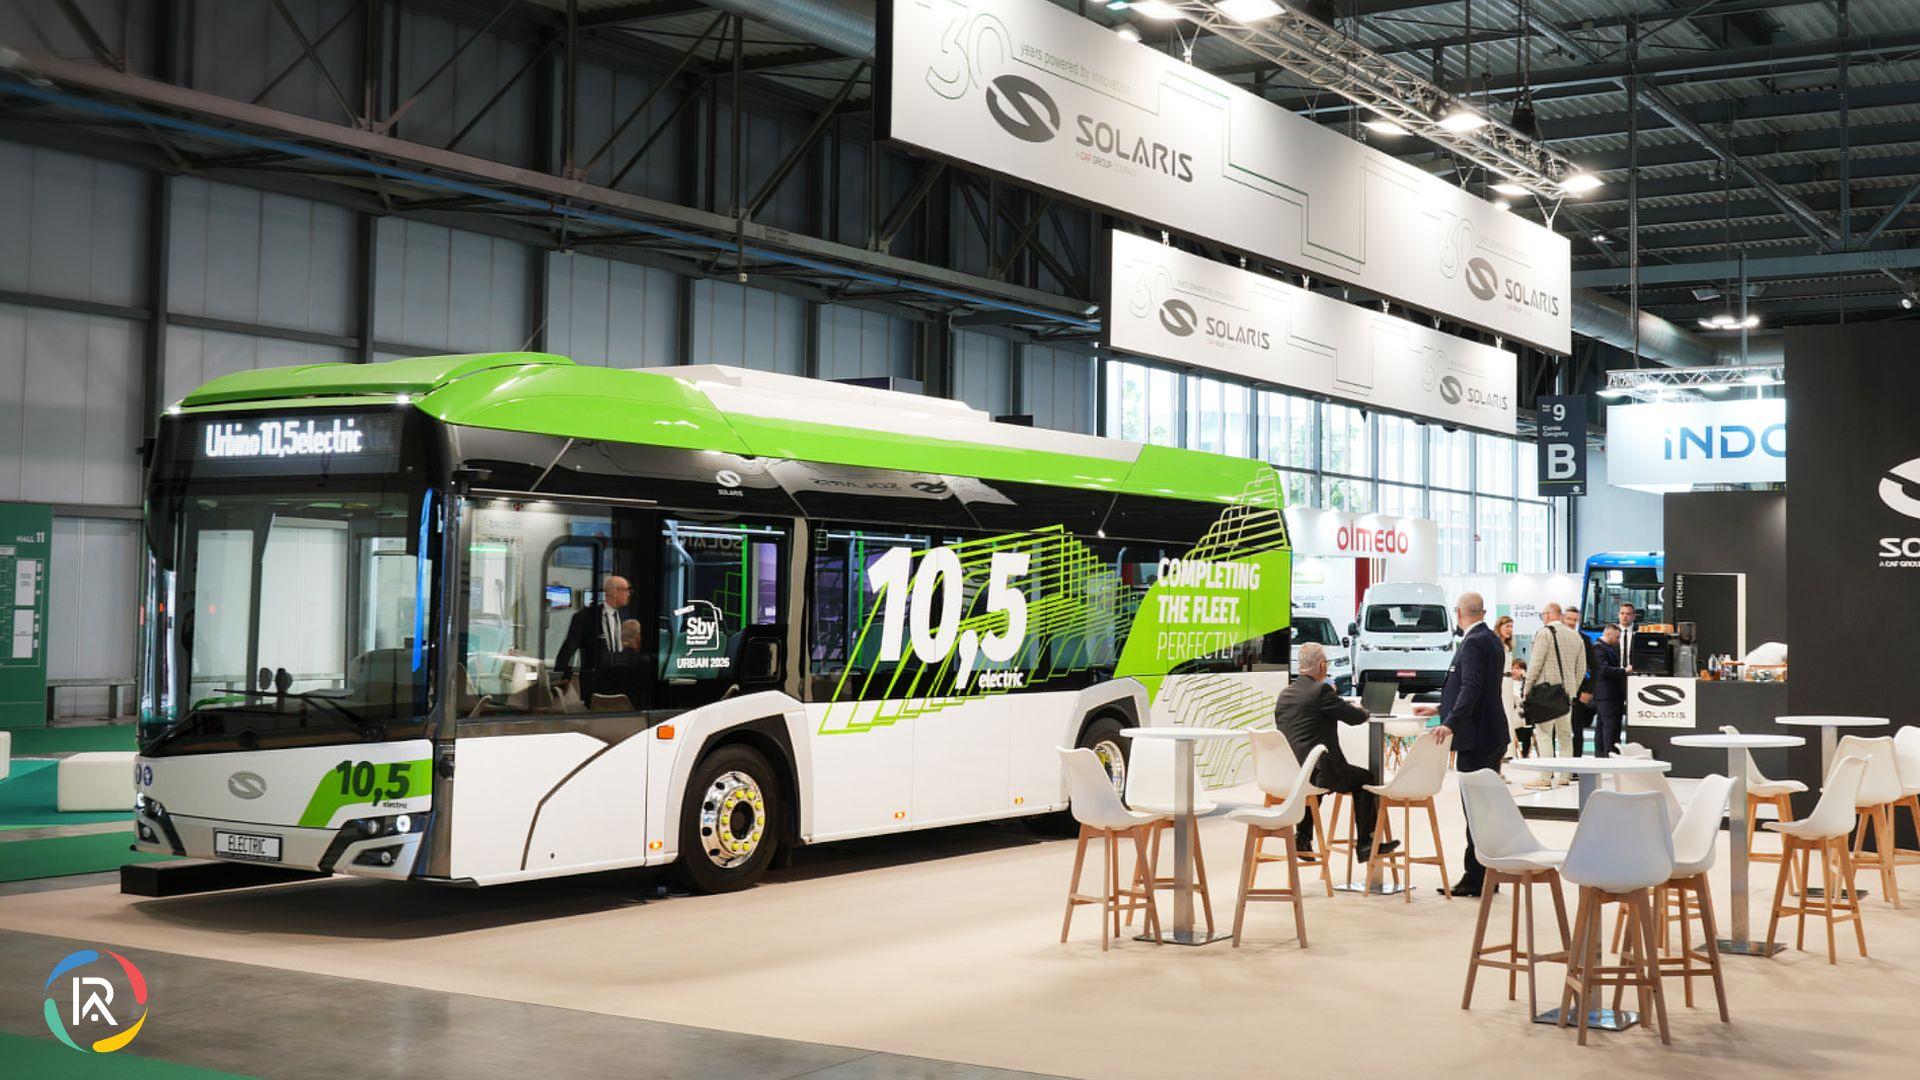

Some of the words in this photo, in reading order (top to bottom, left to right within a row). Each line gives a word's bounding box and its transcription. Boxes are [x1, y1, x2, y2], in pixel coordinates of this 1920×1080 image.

[1044, 52, 1079, 75] powered
[1076, 114, 1193, 184] SOLARIS
[1504, 278, 1560, 317] SOLARIS
[1205, 316, 1271, 351] SOLARIS
[1467, 387, 1509, 411] SOLARIS
[1553, 404, 1566, 421] 9
[205, 422, 261, 458] Urbino
[1547, 443, 1577, 480] B
[1336, 519, 1409, 555] olmedo
[1157, 557, 1262, 591] COMPLETING
[867, 545, 1031, 690] 10,5
[1157, 595, 1190, 624] THE
[1192, 595, 1241, 625] FLEET.
[686, 616, 717, 640] Sby
[1156, 631, 1239, 661] PERFECTLY
[677, 658, 709, 669] URBAN
[978, 666, 1024, 689] electric
[1637, 710, 1687, 720] SOLARIS
[336, 760, 412, 807] 10,5
[382, 800, 409, 809] electric
[228, 834, 266, 855] ELECTRIC
